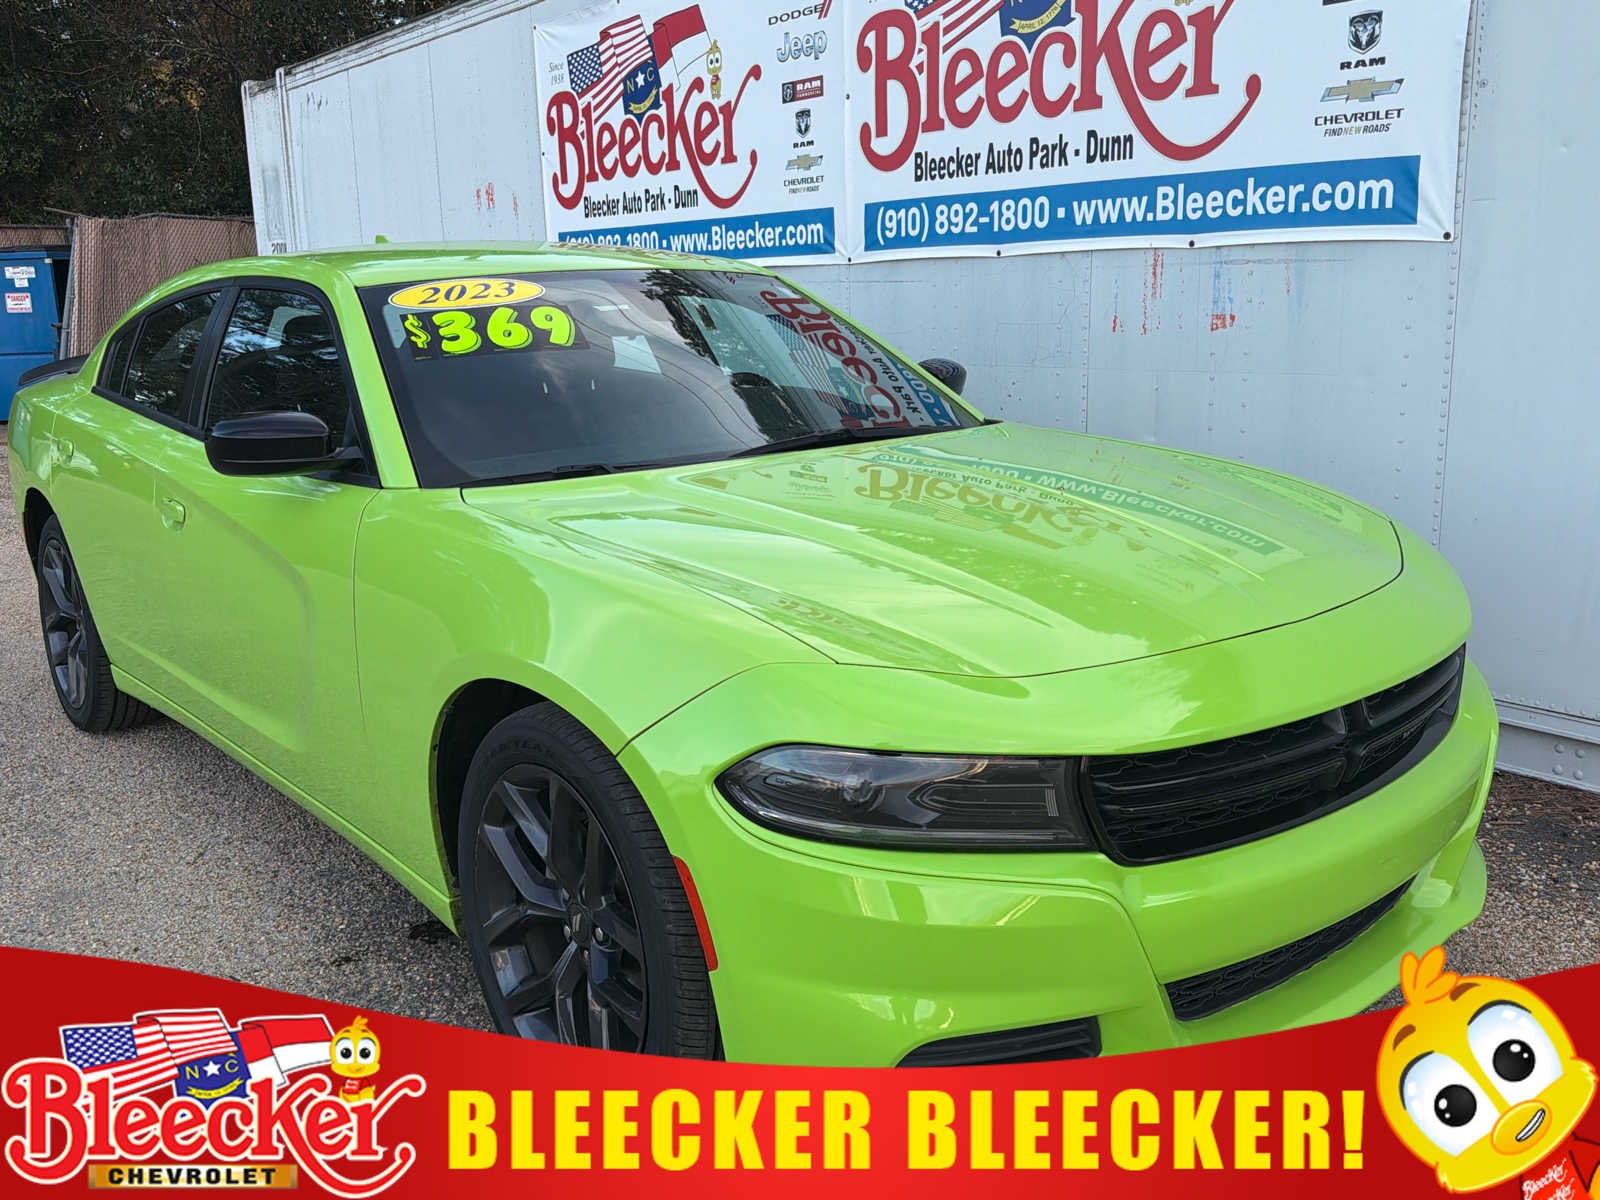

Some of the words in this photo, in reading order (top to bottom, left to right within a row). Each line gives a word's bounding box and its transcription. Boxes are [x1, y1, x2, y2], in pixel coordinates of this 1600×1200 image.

[768, 3, 823, 26] DODGE
[776, 30, 828, 63] Jeep
[1340, 56, 1386, 70] RAM
[796, 80, 820, 91] RAM
[856, 0, 1262, 172] Bleecker
[1314, 108, 1405, 126] CHEVROLET
[546, 64, 762, 210] Bleecker
[793, 140, 815, 149] RAM
[914, 147, 981, 182] Bleecker
[985, 142, 1023, 175] Auto
[1029, 134, 1069, 170] Park
[1086, 129, 1134, 164] Dunn
[784, 175, 824, 187] CHEVROLET
[583, 193, 620, 218] Bleecker
[622, 191, 642, 214] Auto
[644, 186, 666, 212] Park
[673, 184, 699, 209] Dunn
[877, 203, 929, 245] (910)
[935, 196, 1050, 234] 892-1800
[1072, 177, 1394, 225] www.Bleecker.com
[669, 221, 824, 252] www.Bleecker.com
[417, 281, 516, 305] 2023
[404, 306, 576, 354] $369
